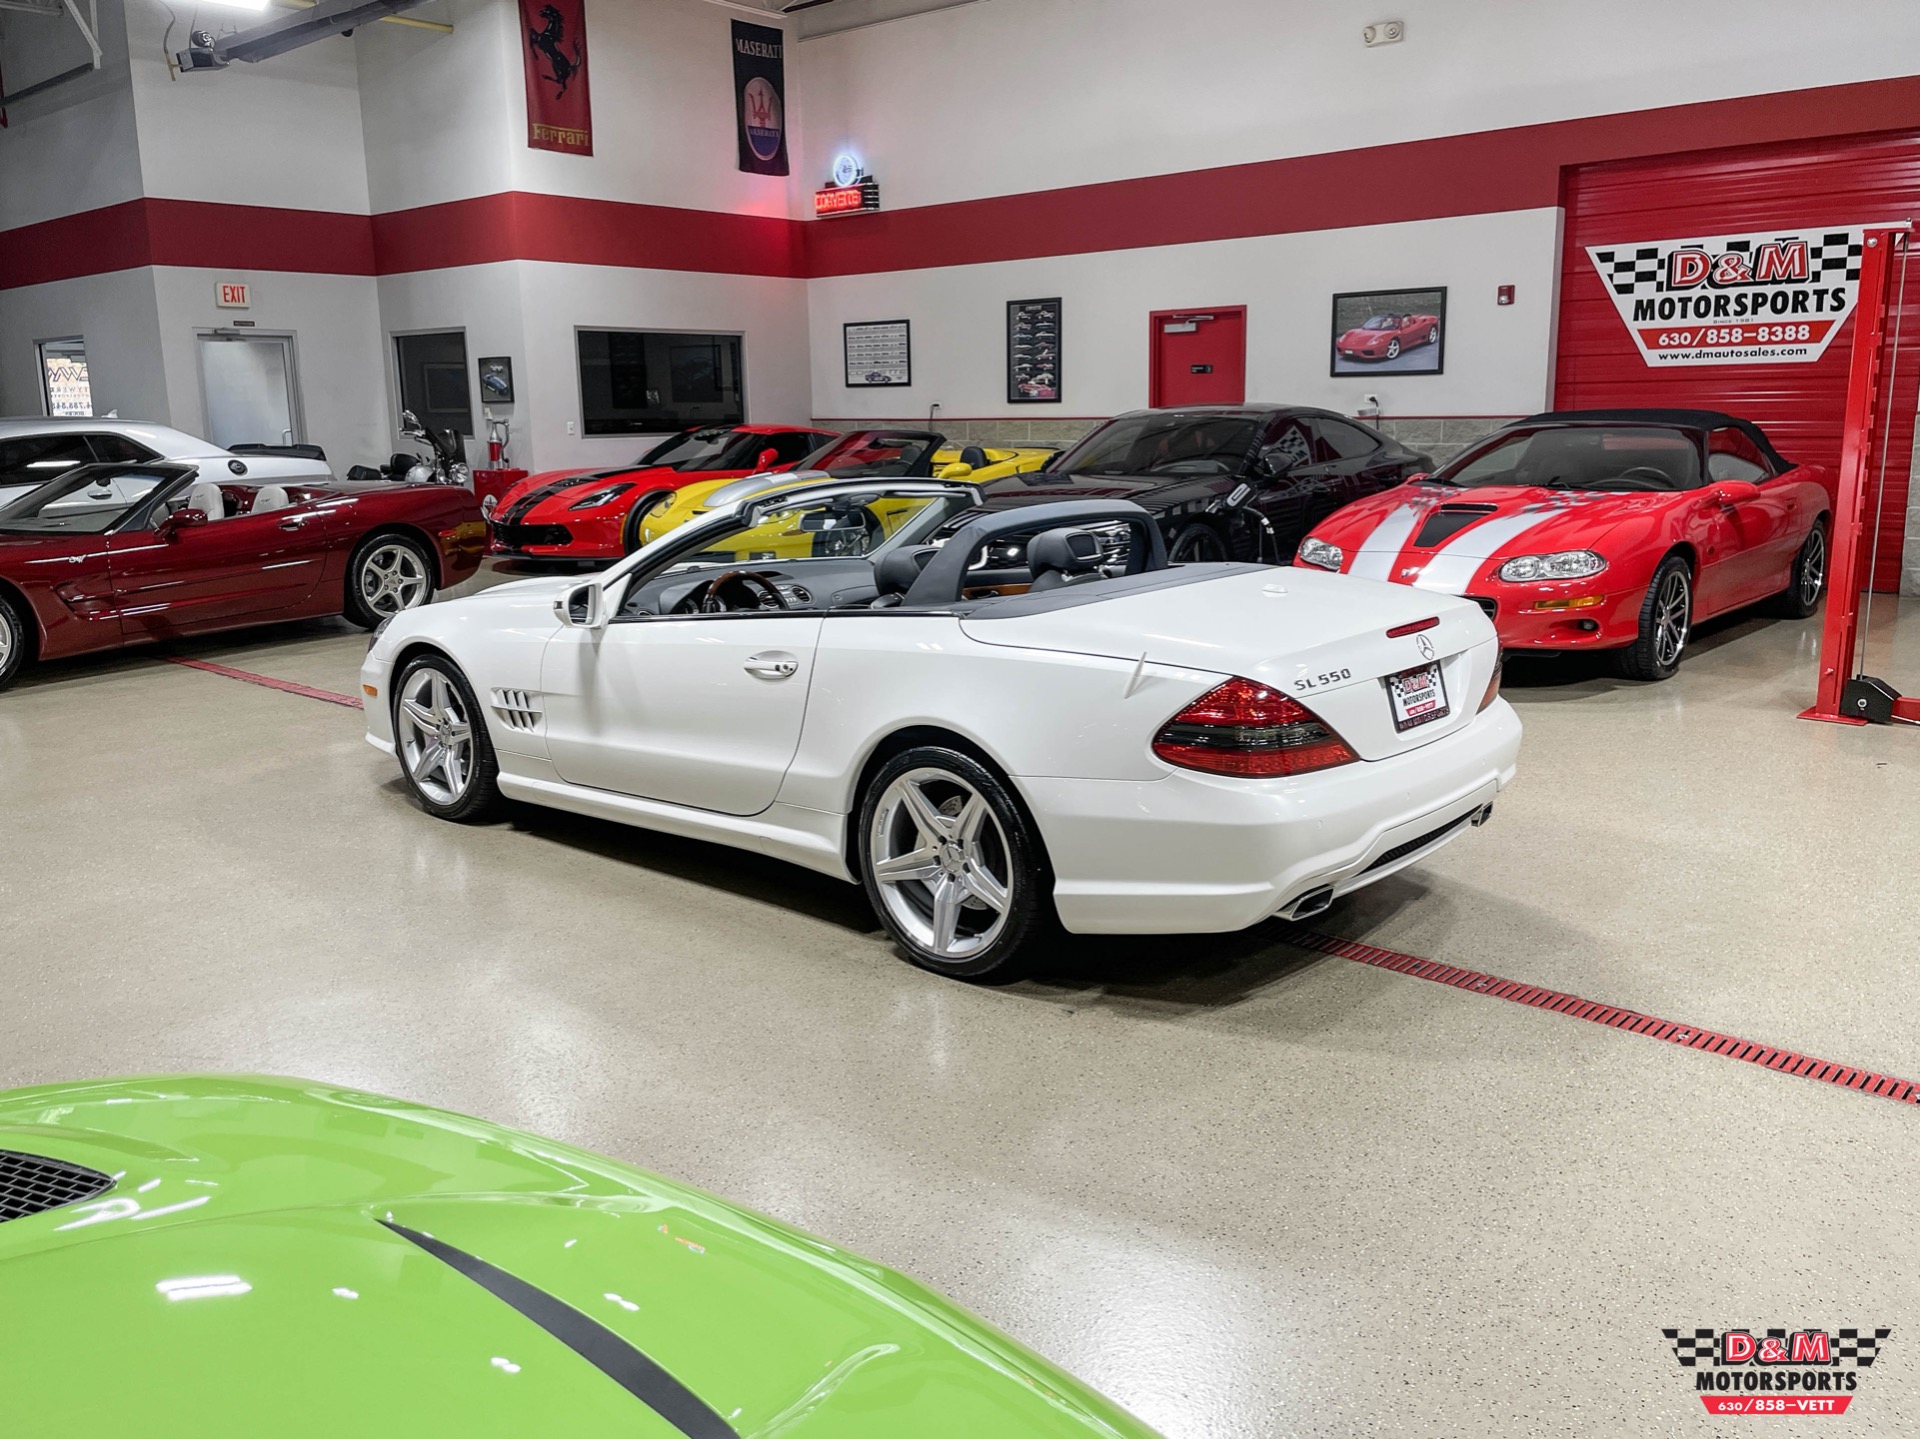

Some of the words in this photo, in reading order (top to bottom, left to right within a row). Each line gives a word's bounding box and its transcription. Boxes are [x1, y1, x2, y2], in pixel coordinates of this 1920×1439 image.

[532, 123, 589, 146] Ferrari
[1670, 242, 1809, 290] D&M
[223, 285, 245, 303] EXIT
[1633, 288, 1846, 322] MOTORSPORTS
[1658, 324, 1810, 346] 630/858-8388
[1658, 346, 1807, 361] www.dmautosales.com
[1294, 678, 1317, 691] SL
[1318, 668, 1351, 685] 550
[1403, 689, 1436, 706] MOTORSPORTS
